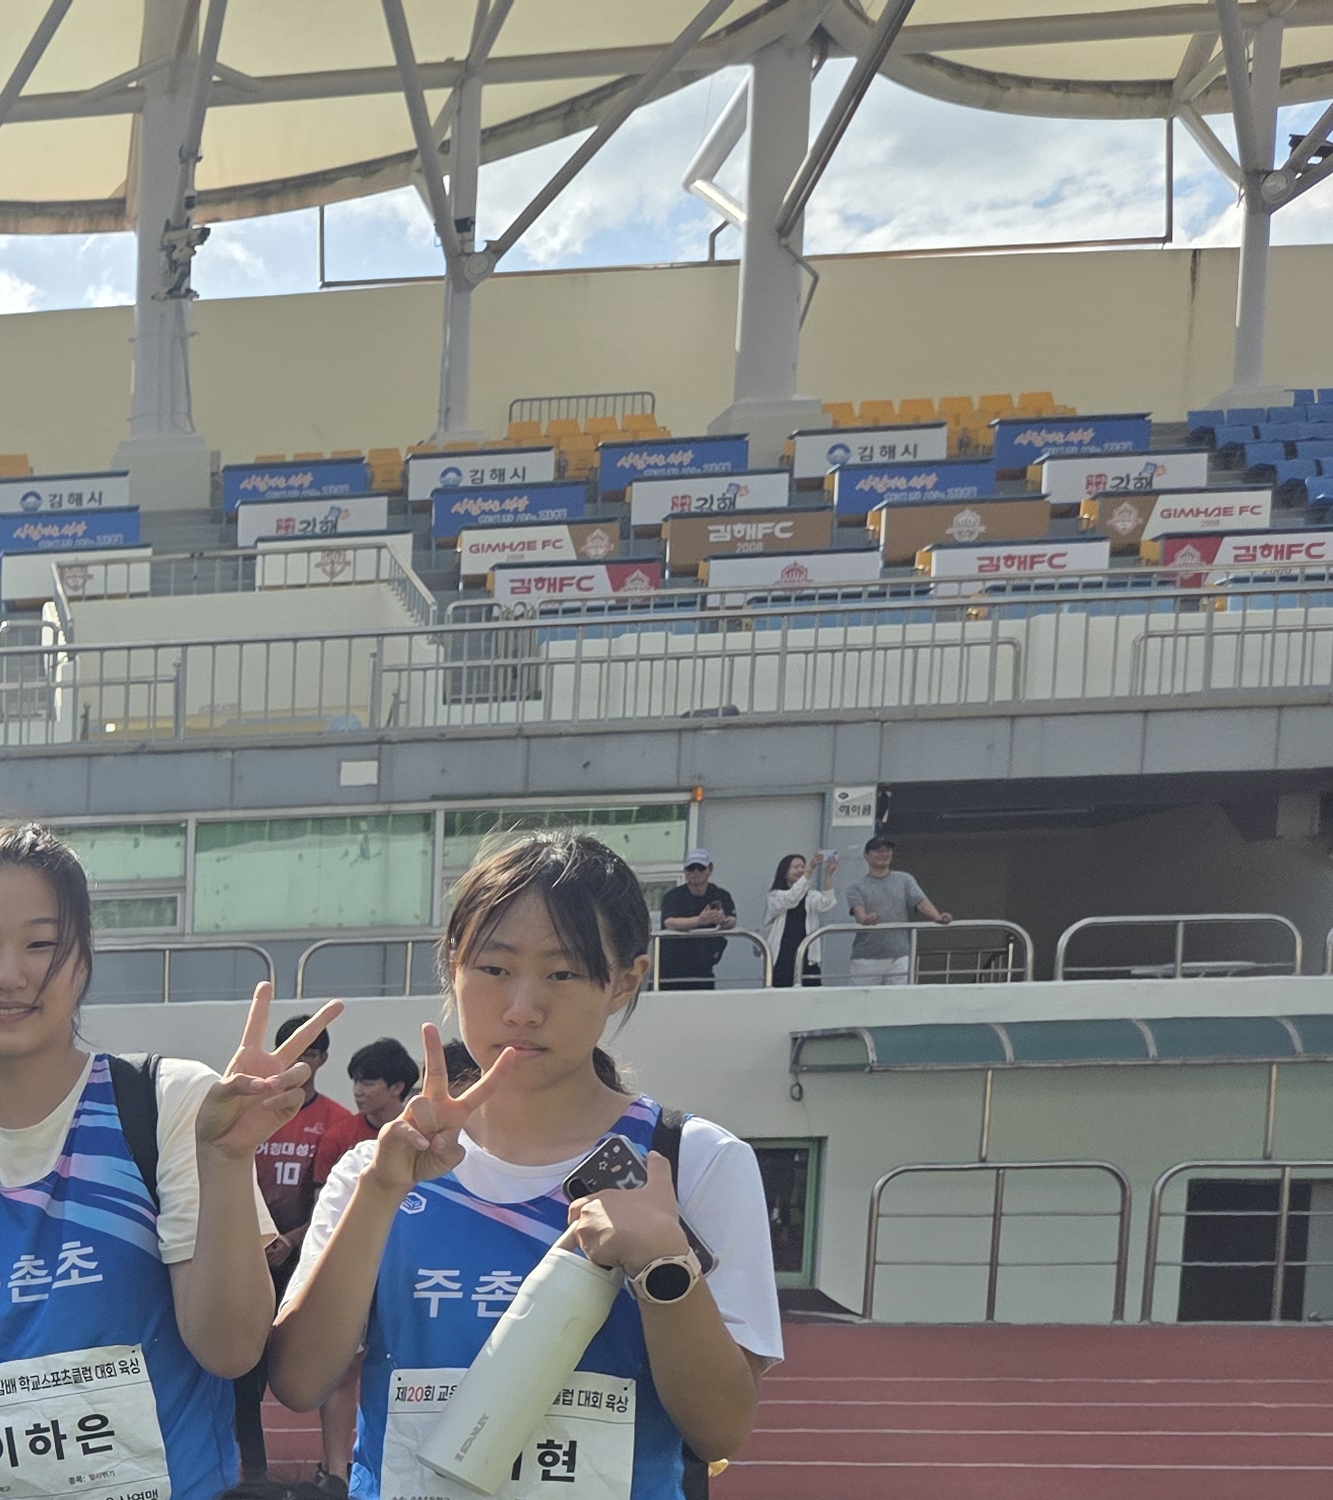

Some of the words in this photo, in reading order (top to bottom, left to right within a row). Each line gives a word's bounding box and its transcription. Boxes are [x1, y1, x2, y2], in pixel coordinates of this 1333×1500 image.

[858, 443, 918, 461] 김해시
[469, 466, 527, 483] 김해시
[48, 491, 103, 508] 김해시
[1160, 505, 1235, 520] GIMHAE
[1238, 504, 1263, 516] FC
[707, 521, 794, 542] 김해FC
[468, 539, 537, 555] GIMHAE
[541, 538, 564, 550] FC
[1232, 542, 1326, 563] 김해FC
[976, 553, 1068, 573] 김해FC
[509, 575, 595, 595] 김해FC
[275, 1162, 301, 1185] 10
[413, 1268, 525, 1318] 주촌
[18, 1366, 93, 1391] 학교스포츠클럽
[95, 1363, 118, 1379] 대회
[118, 1358, 140, 1375] 육상
[395, 1385, 435, 1402] 제20회
[577, 1390, 603, 1410] 대회
[605, 1393, 629, 1413] 육상
